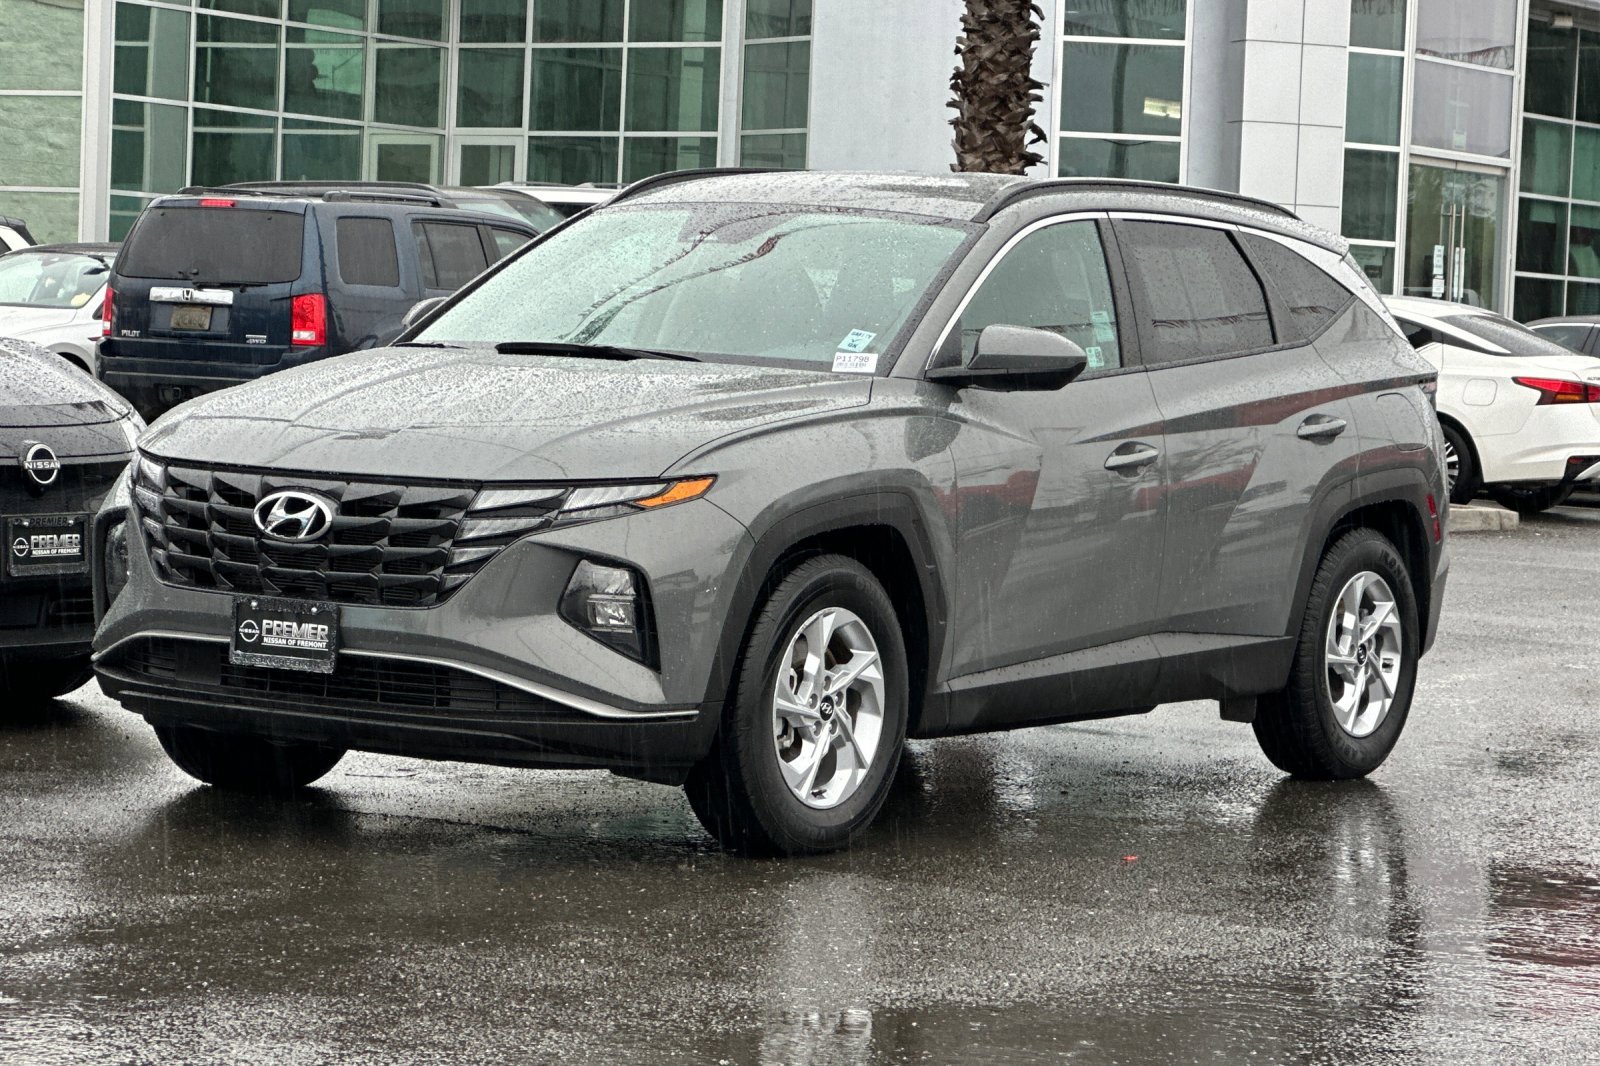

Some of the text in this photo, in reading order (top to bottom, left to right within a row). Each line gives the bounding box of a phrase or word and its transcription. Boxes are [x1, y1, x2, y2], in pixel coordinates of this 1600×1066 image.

[121, 329, 140, 337] PILOT
[835, 355, 870, 363] P11798
[25, 461, 60, 469] NISSAN
[31, 534, 80, 548] PREMIER
[262, 619, 328, 640] PREMIER
[263, 636, 287, 645] NISSAN
[297, 640, 327, 649] FREMONT
